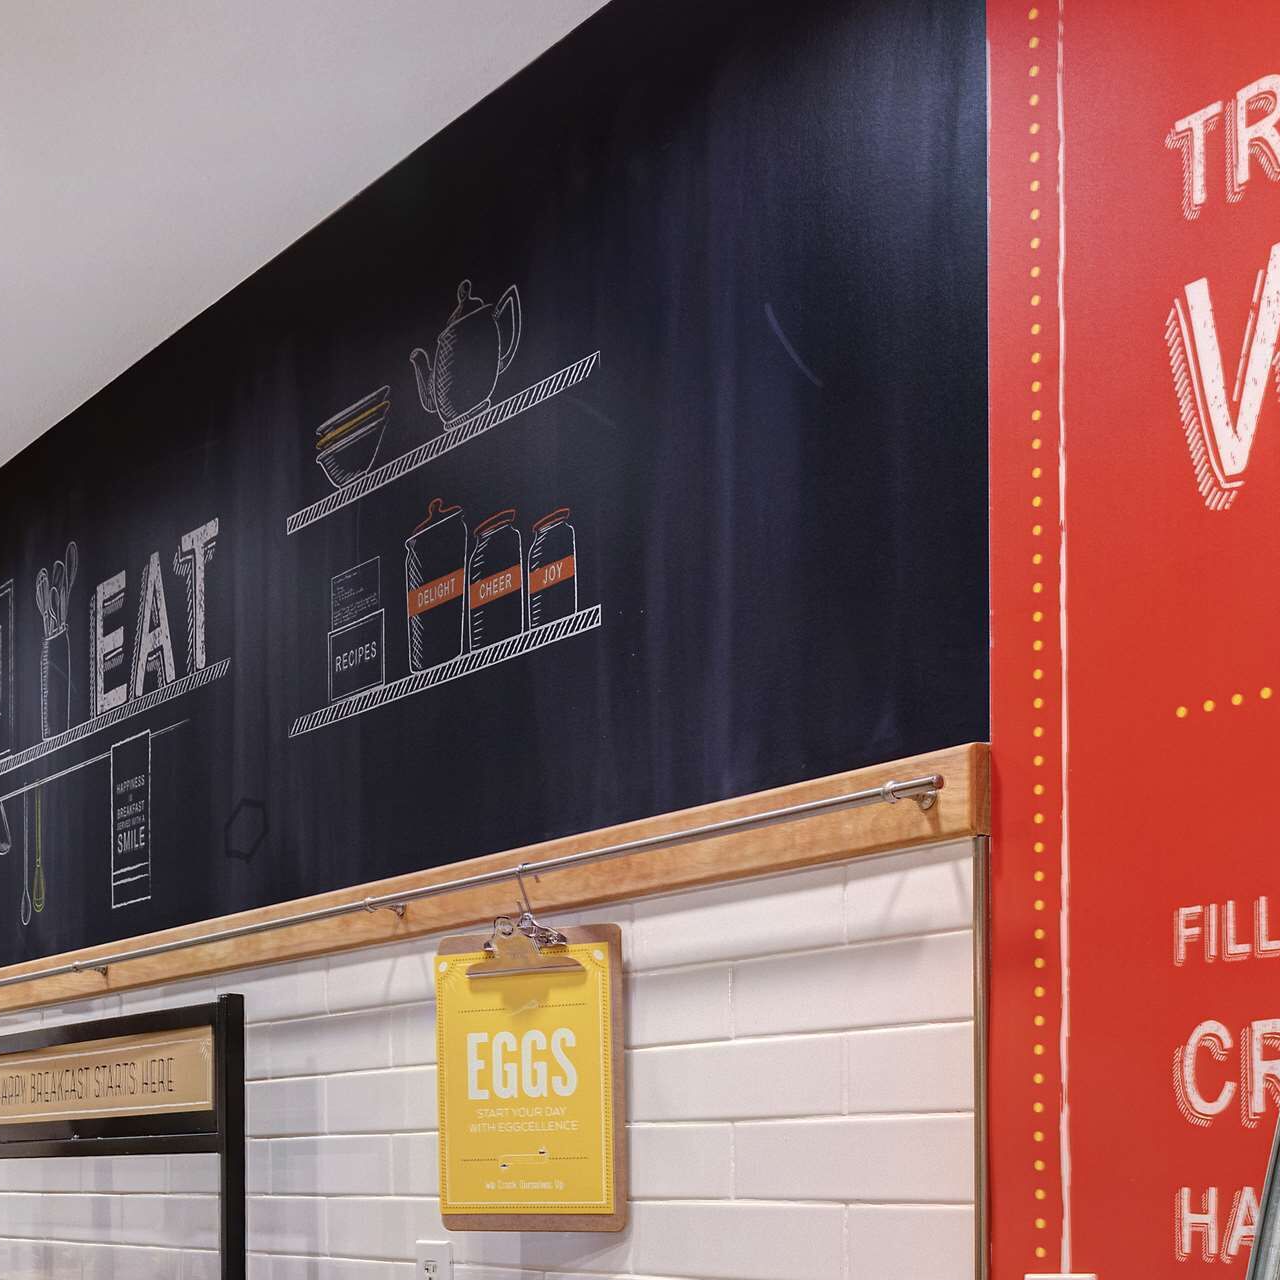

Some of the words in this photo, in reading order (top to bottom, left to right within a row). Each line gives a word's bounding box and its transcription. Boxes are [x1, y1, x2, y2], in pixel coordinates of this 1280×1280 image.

[479, 573, 512, 600] CHEER
[542, 562, 563, 585] JOY
[417, 578, 456, 607] DELIGHT
[90, 517, 219, 718] EAT
[335, 641, 377, 672] RECIPES
[117, 826, 145, 853] SMILE
[466, 1027, 578, 1100] EGGS
[30, 1067, 90, 1104] BREAKFAST
[94, 1062, 136, 1098] STARTS
[141, 1057, 176, 1094] HERE
[477, 1108, 511, 1120] START
[511, 1107, 543, 1118] YOUR
[545, 1105, 568, 1117] DAY
